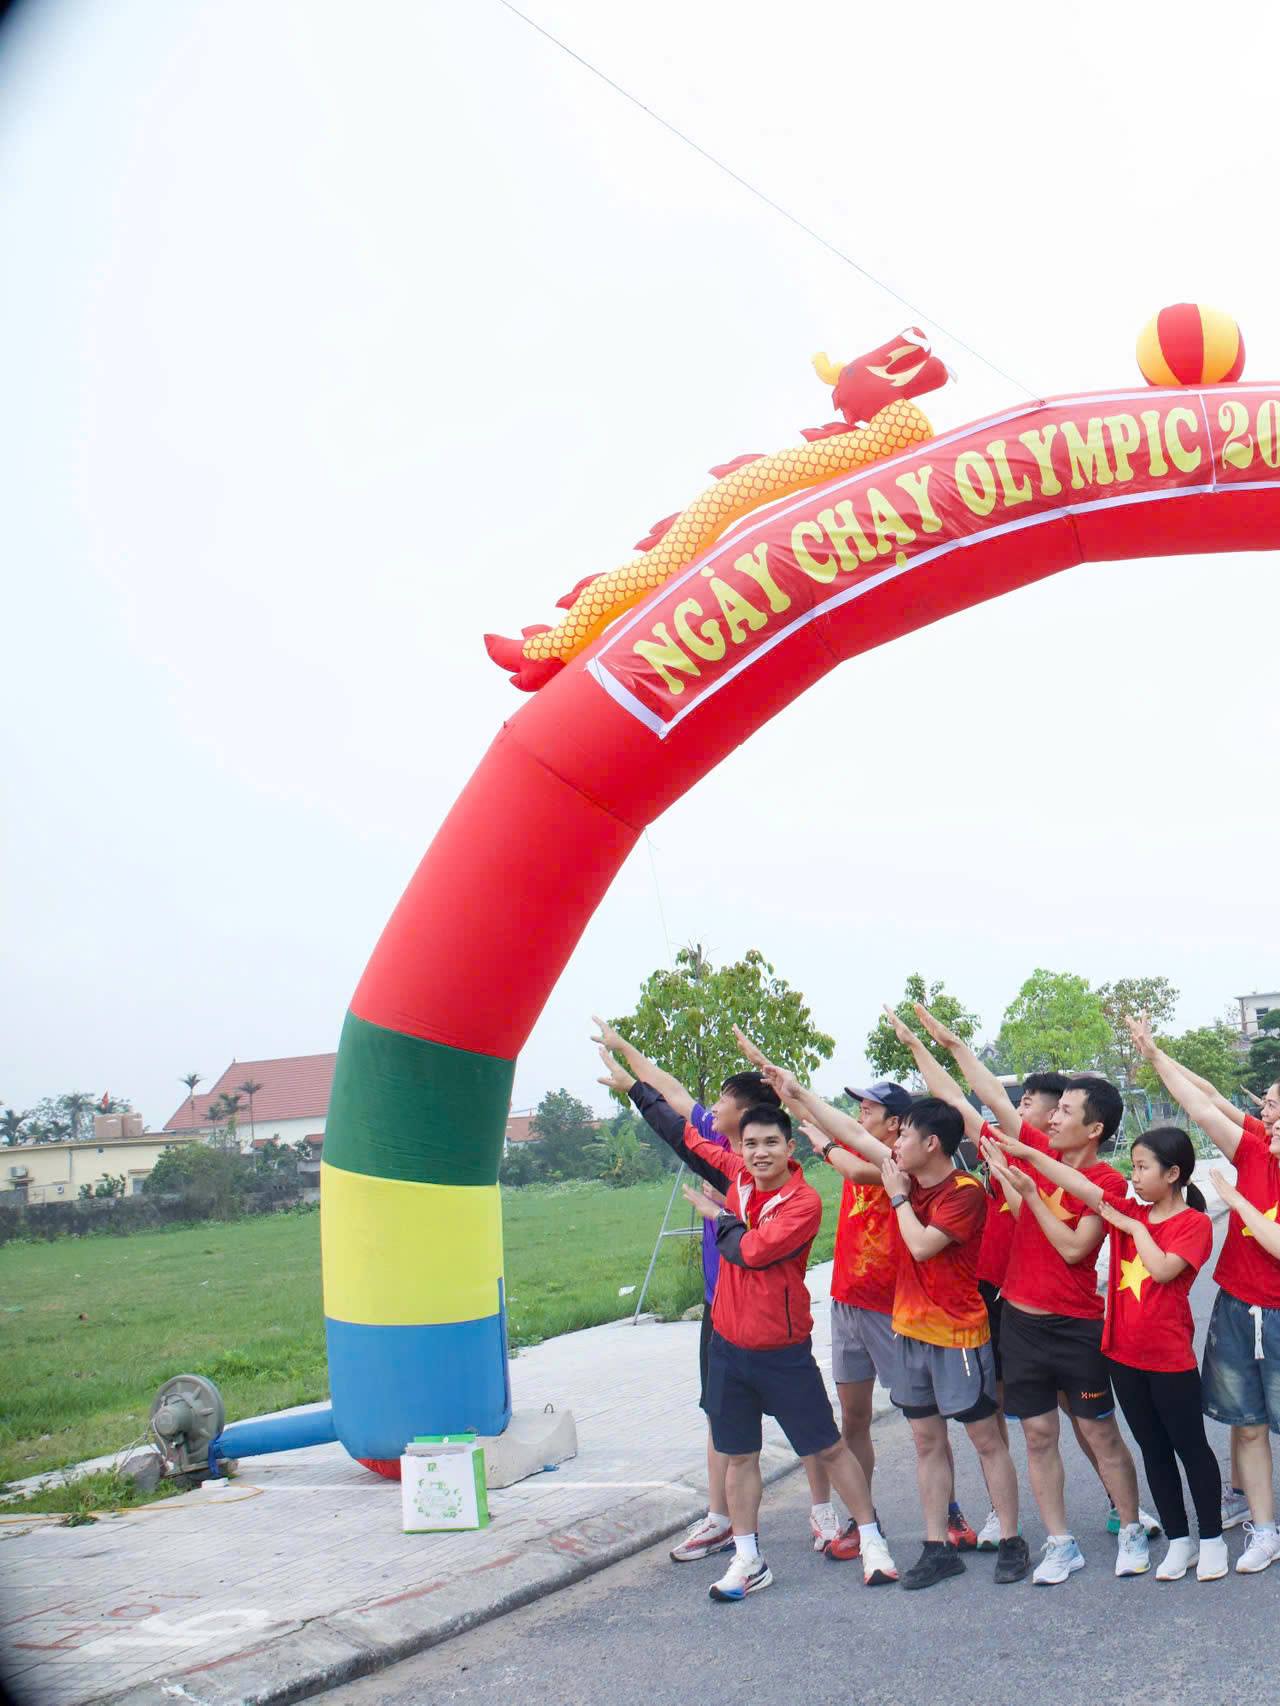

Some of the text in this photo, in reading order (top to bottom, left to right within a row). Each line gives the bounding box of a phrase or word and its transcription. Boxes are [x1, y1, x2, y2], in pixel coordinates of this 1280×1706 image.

[634, 543, 791, 695] NGÀY
[791, 465, 943, 584] CHẠY
[954, 408, 1203, 517] OLYMPIC
